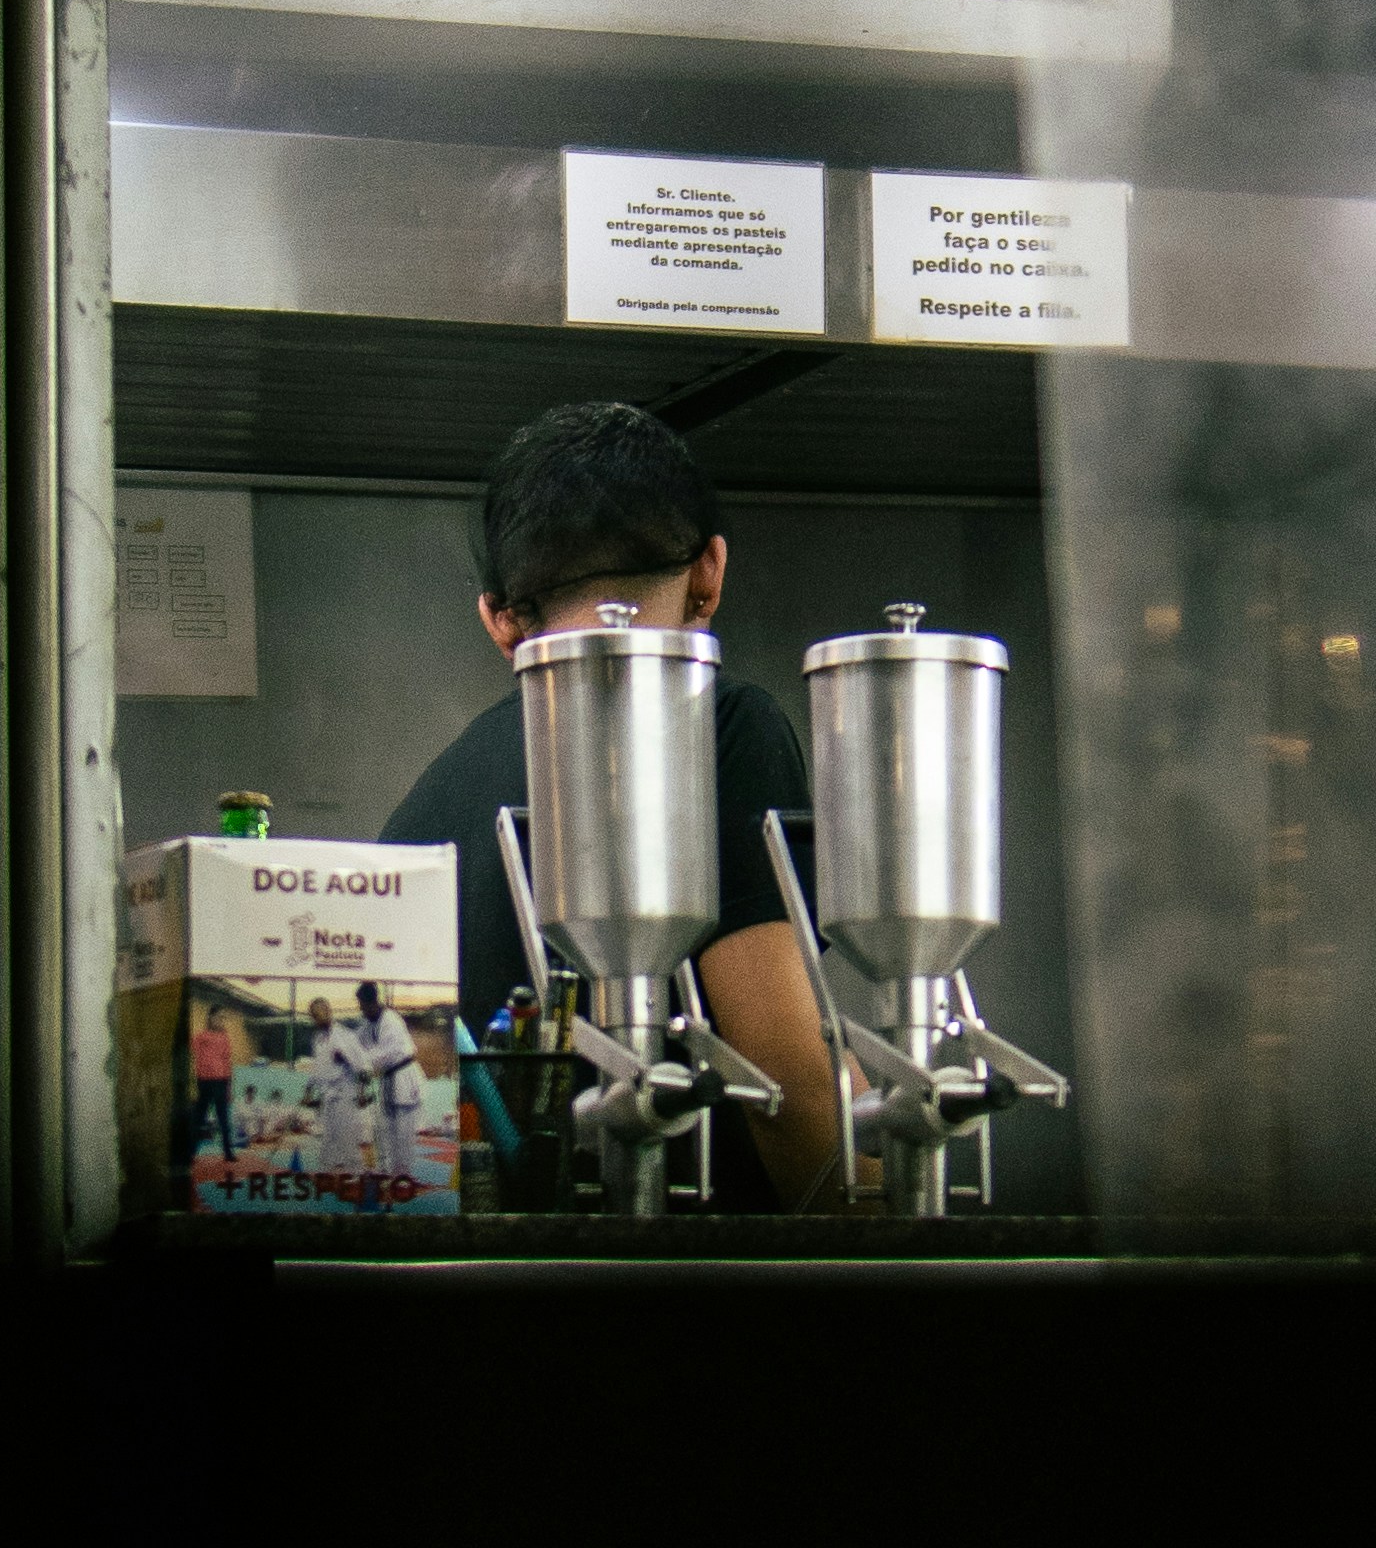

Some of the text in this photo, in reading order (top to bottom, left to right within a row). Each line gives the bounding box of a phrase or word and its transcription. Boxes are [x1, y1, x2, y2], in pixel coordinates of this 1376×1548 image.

[657, 187, 675, 200] Sr.
[627, 203, 766, 221] Informamos que só
[930, 206, 1072, 228] Por gentileza
[606, 220, 786, 239] entregaremos os pasteis
[611, 236, 782, 257] mediante apresentação
[944, 232, 1056, 252] faça o seu
[650, 255, 743, 270] da comanda.
[912, 257, 982, 275] pedido
[990, 262, 1014, 275] no
[617, 298, 780, 316] Obrigada pela compreensão
[920, 298, 1012, 319] Respeite
[1019, 305, 1031, 318] a
[254, 867, 402, 897] DOE AQUI
[314, 929, 365, 948] Nota
